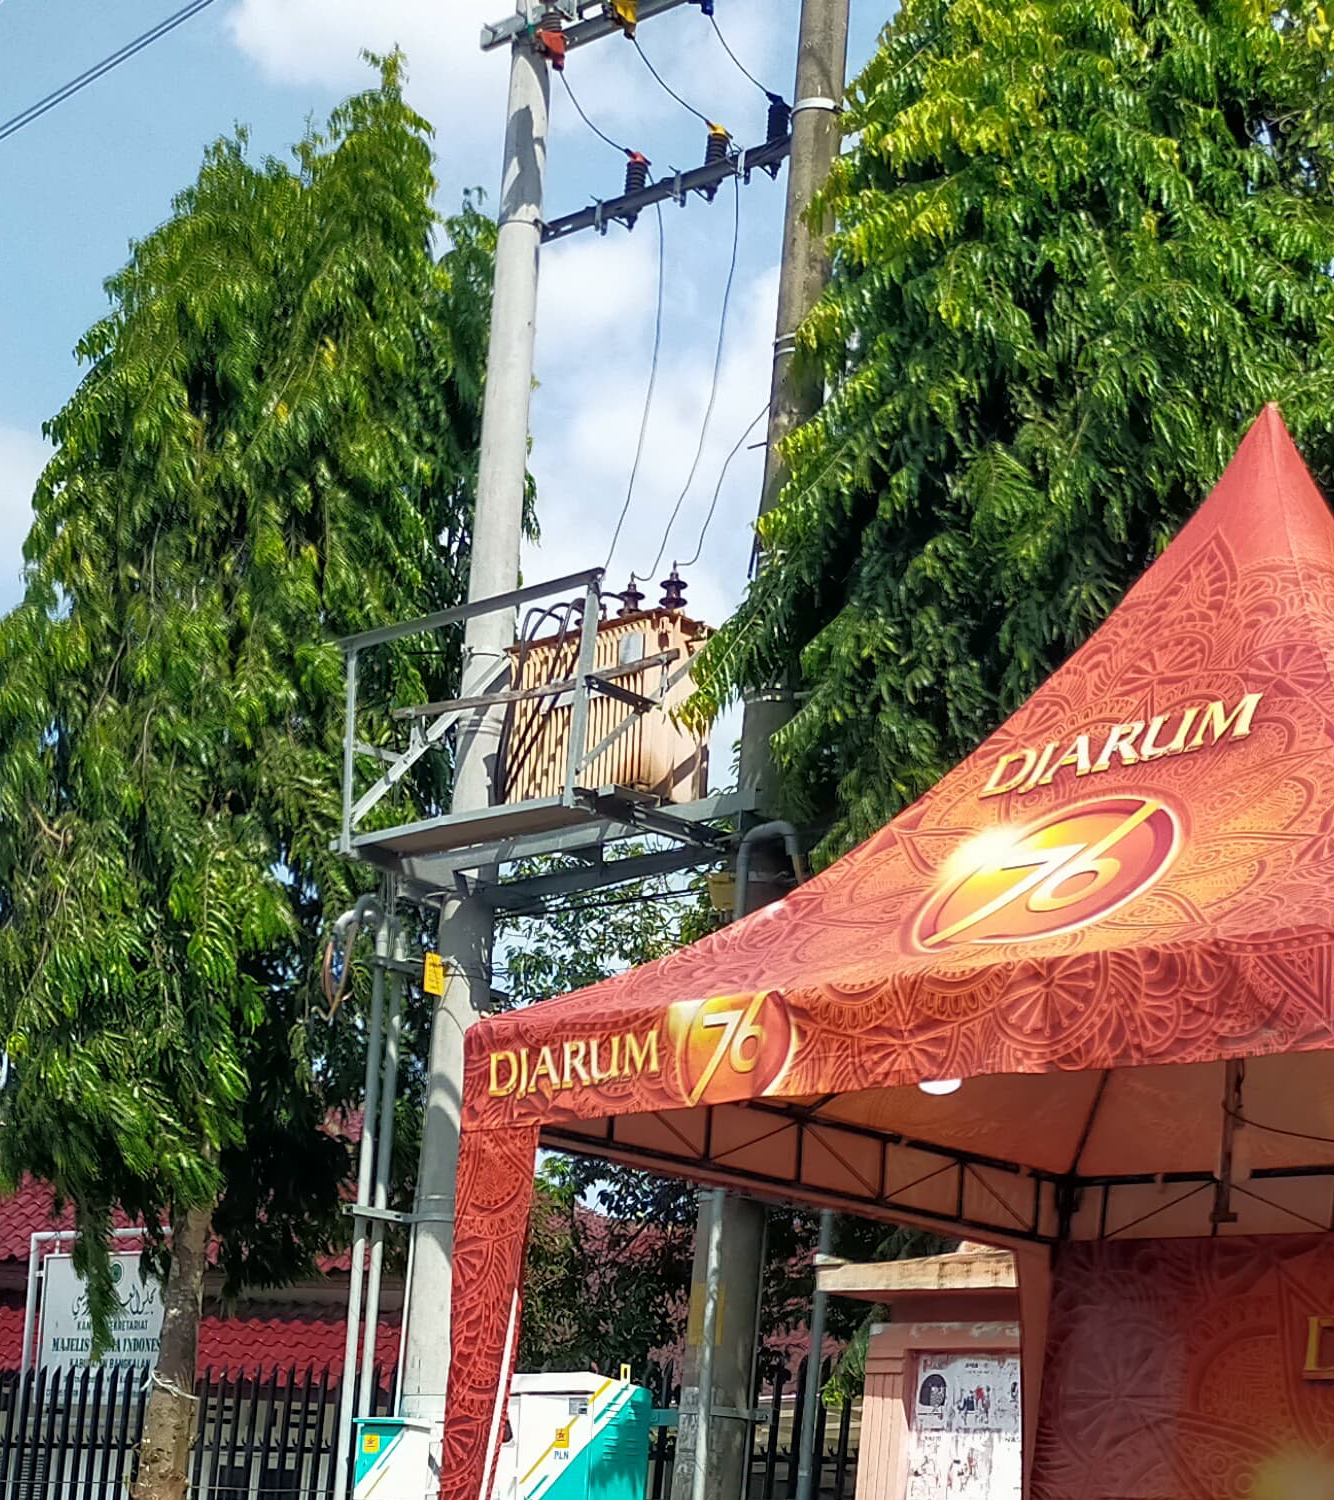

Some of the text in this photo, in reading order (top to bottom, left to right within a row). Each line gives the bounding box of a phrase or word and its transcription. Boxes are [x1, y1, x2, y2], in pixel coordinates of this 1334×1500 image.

[978, 693, 1263, 799] DJARUM
[487, 1030, 661, 1098] DJARUM
[51, 1337, 90, 1352] MAJELIS
[122, 1336, 161, 1352] INDONES
[554, 1450, 569, 1460] PLN
